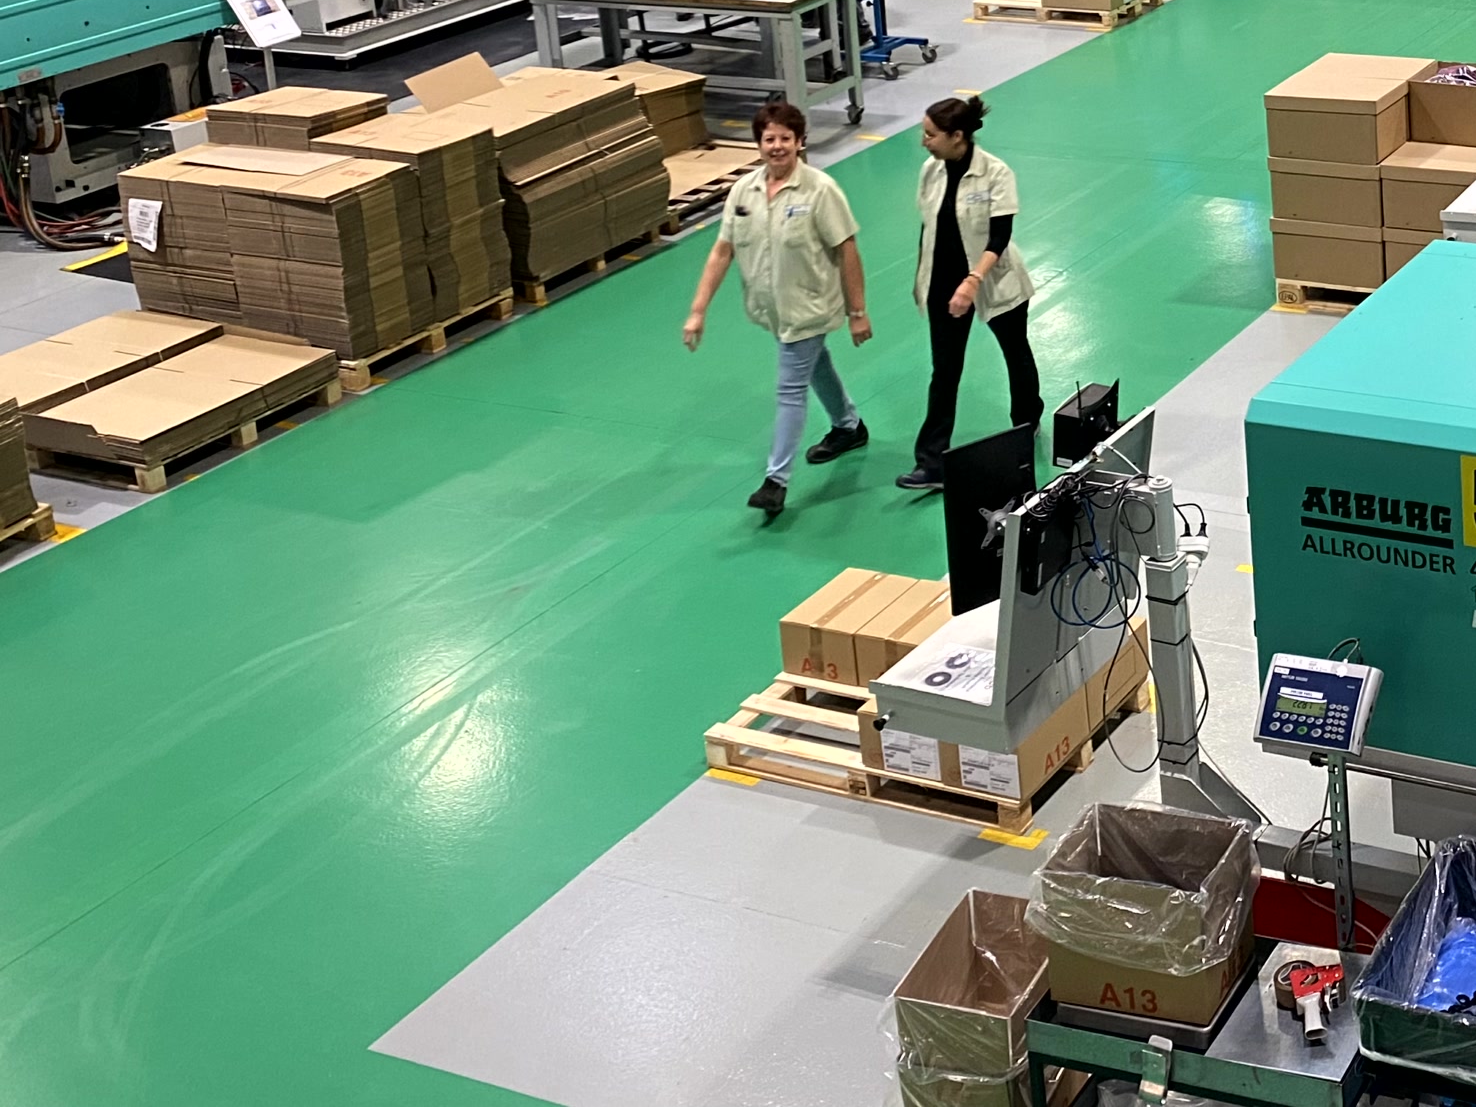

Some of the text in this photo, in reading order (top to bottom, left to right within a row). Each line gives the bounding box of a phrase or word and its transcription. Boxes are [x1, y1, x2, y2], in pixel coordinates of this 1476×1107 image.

[1301, 486, 1453, 534] ARBURG
[1301, 533, 1457, 575] ALLROUNDER
[1044, 736, 1071, 775] A13
[1099, 982, 1159, 1014] A13
